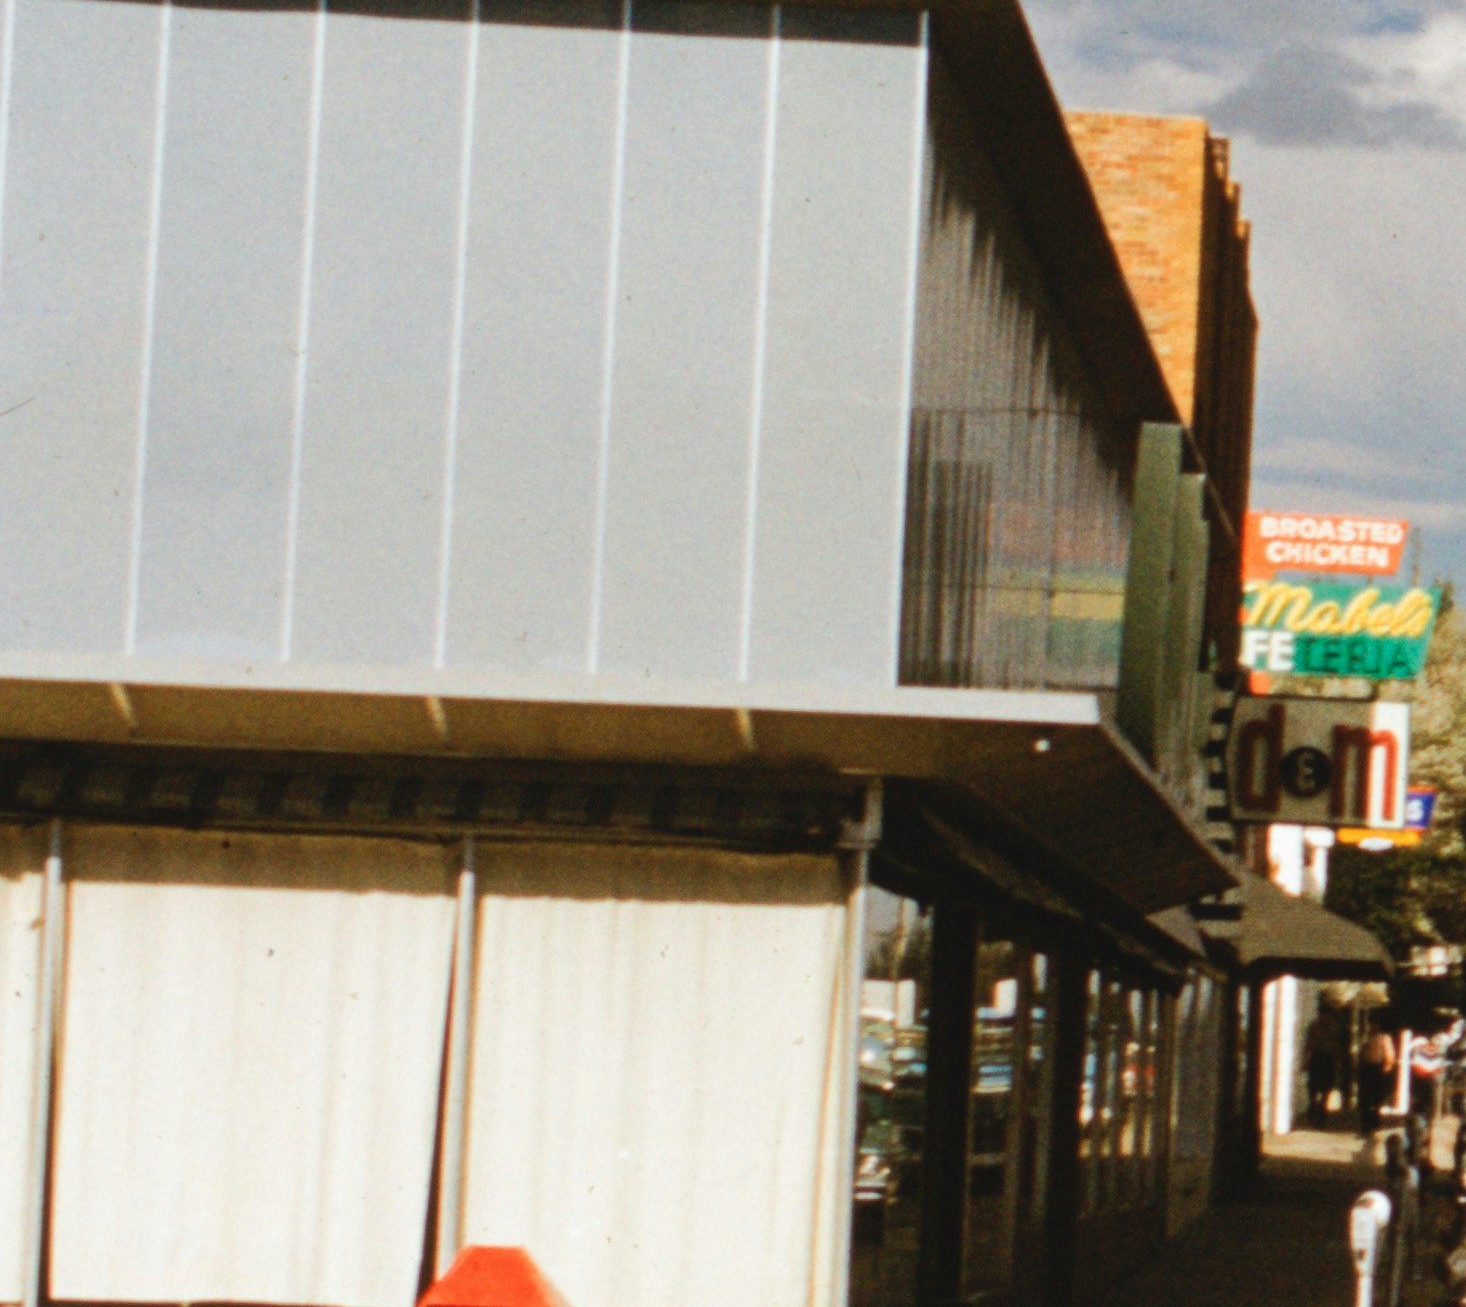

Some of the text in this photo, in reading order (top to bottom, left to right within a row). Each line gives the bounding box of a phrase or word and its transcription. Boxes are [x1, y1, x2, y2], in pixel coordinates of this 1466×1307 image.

[1260, 516, 1404, 544] BROASTED
[1265, 541, 1390, 568] CHICKEN
[1240, 629, 1416, 677] FETERIA
